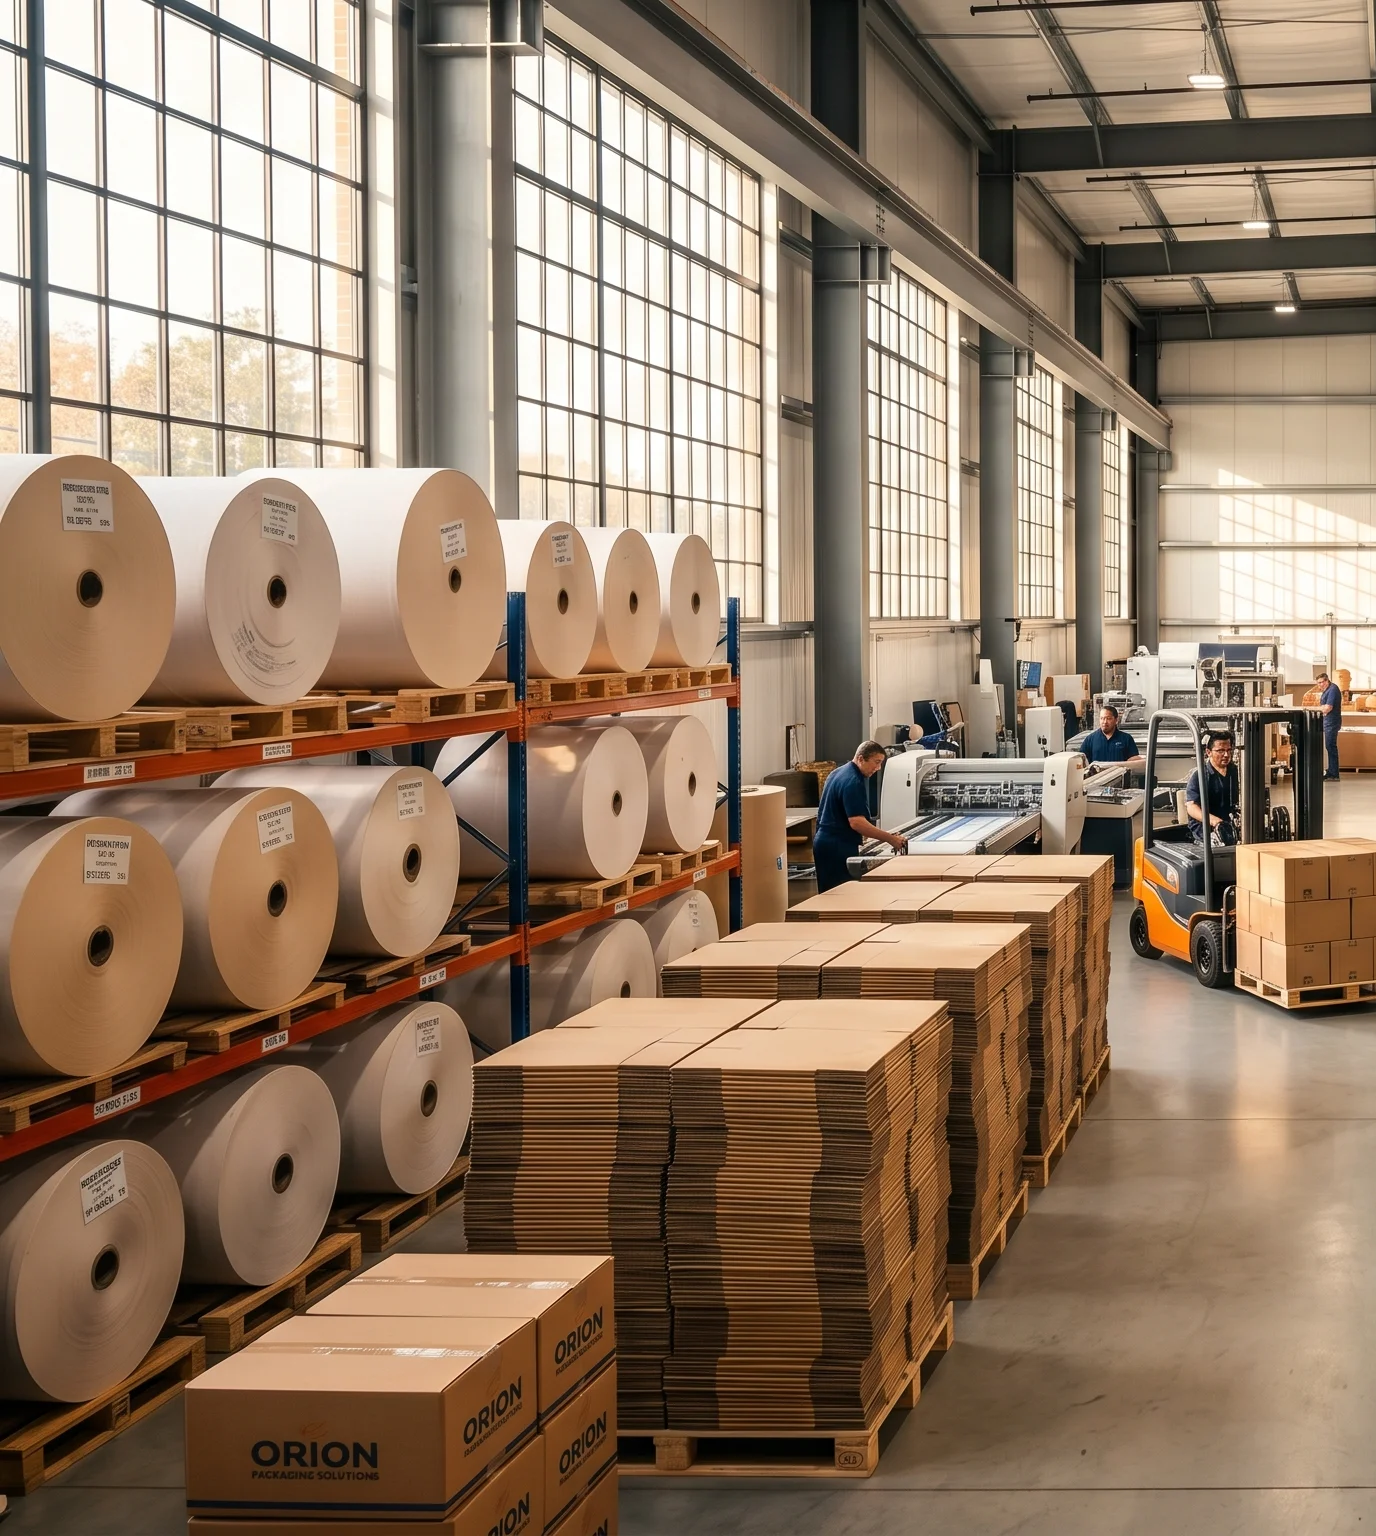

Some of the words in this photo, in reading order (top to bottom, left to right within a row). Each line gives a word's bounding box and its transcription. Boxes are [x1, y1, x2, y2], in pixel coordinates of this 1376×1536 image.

[554, 1305, 603, 1365] ORION
[463, 1375, 522, 1445] ORION
[250, 1439, 379, 1470] ORION
[559, 1410, 607, 1475] ORION
[317, 1471, 380, 1481] SOLUTIONS
